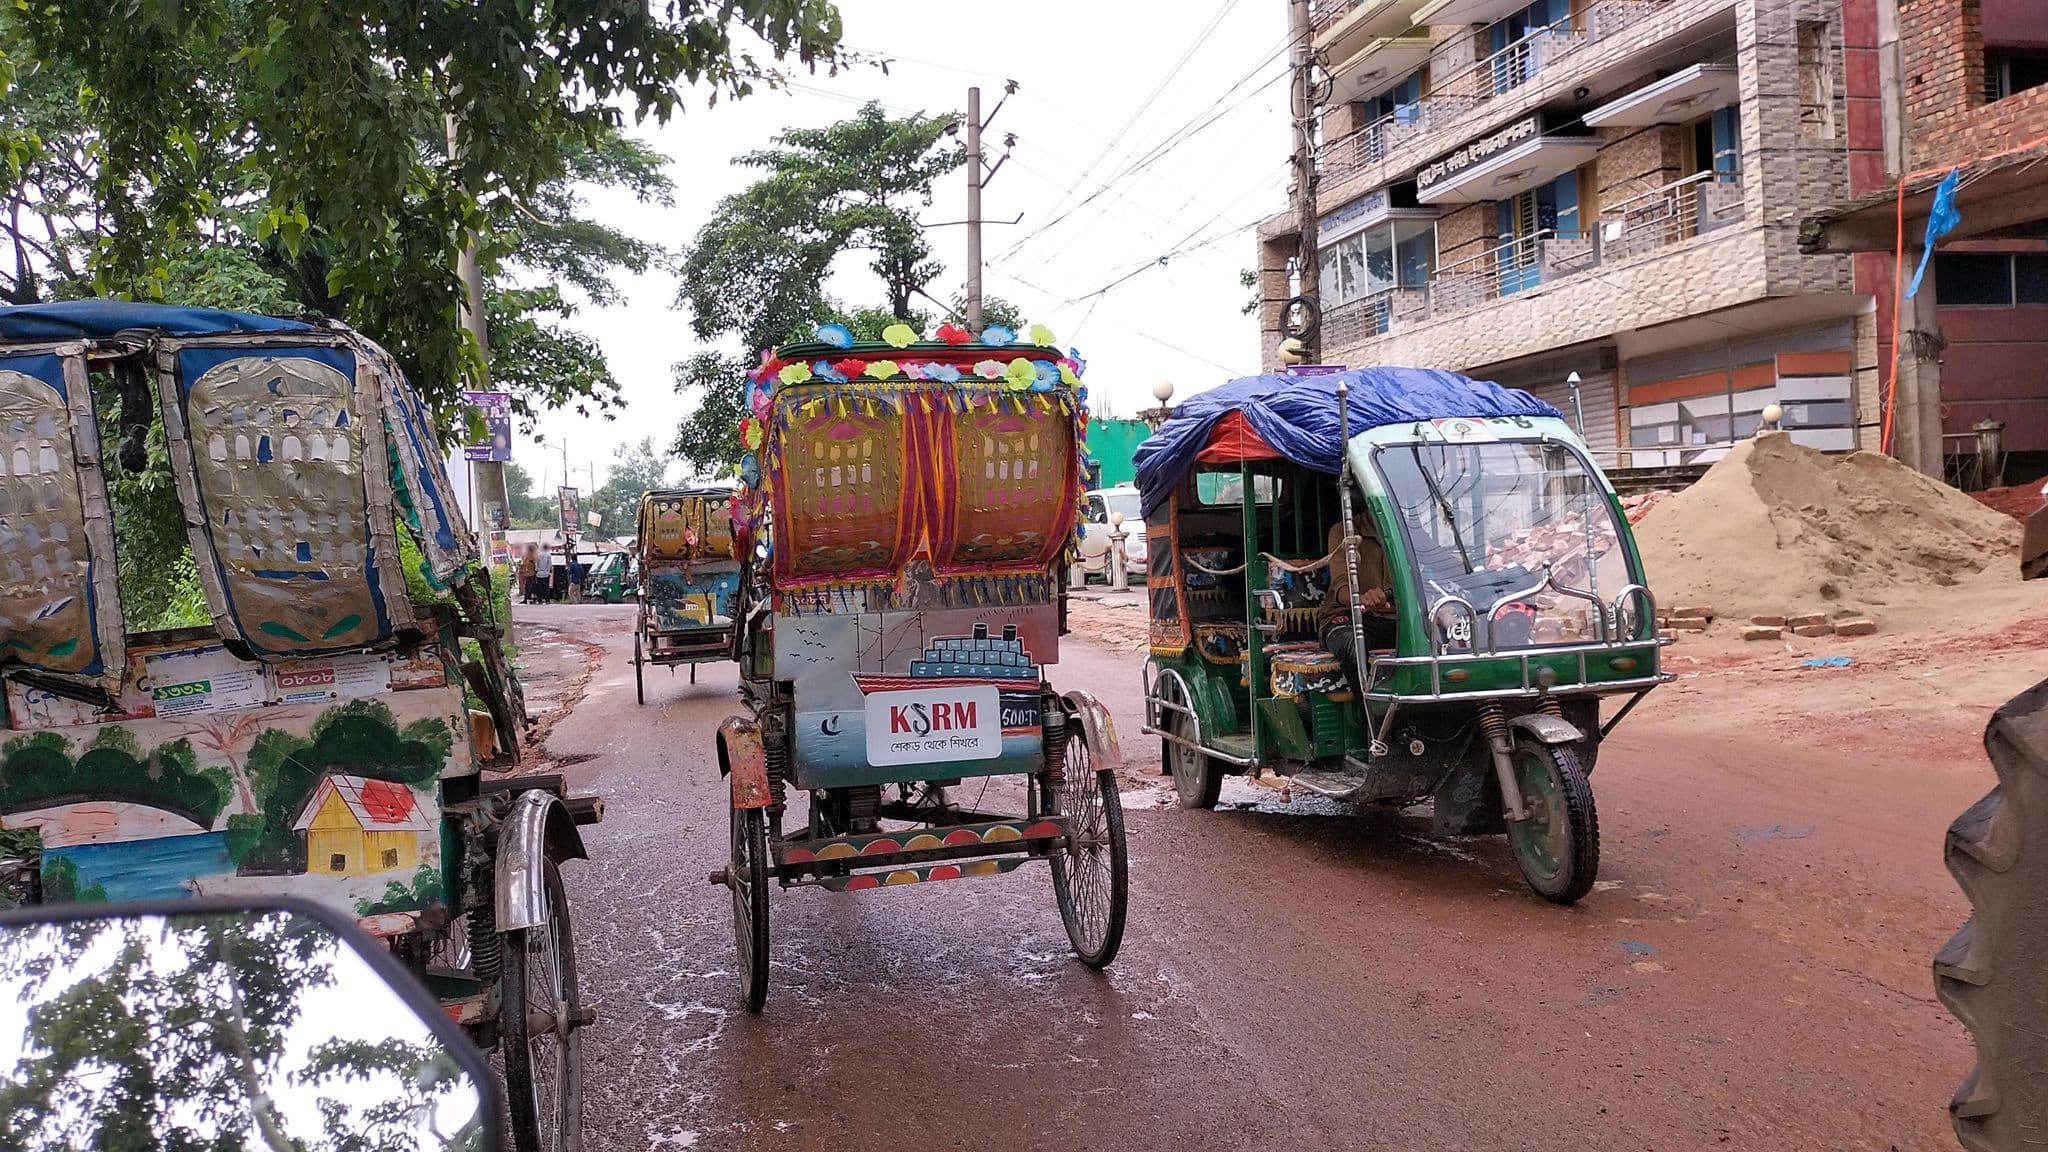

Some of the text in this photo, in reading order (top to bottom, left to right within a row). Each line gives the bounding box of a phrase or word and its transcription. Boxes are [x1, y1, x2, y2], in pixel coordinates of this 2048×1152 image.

[281, 673, 335, 686] ০৮০৮
[158, 684, 207, 699] ১৩৩২
[890, 702, 977, 737] KSRM
[890, 736, 979, 753] শেকড় থেকে শিখরে
